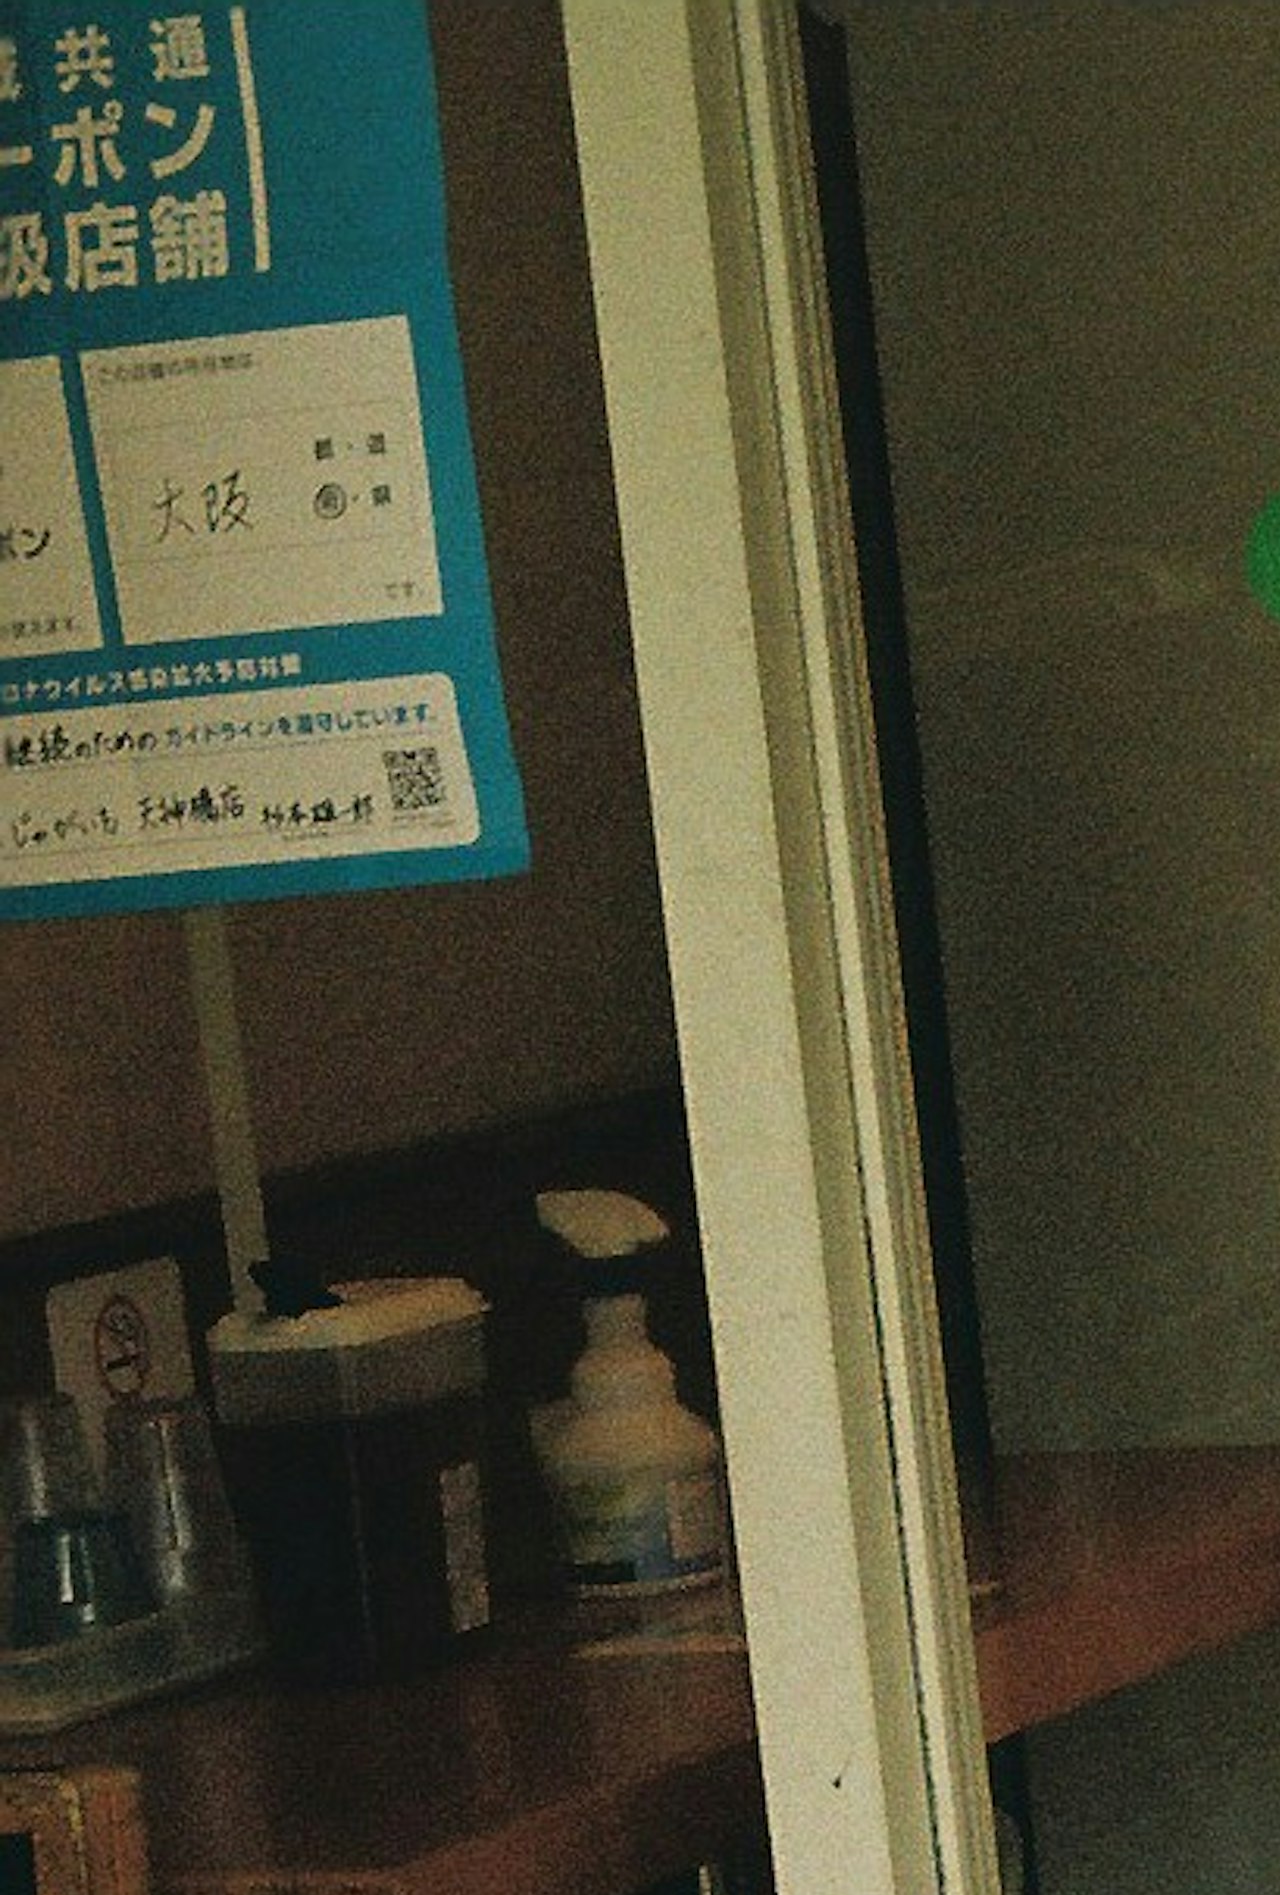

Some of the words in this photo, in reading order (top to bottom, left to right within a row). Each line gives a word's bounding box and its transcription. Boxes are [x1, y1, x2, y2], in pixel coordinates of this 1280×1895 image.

[0, 190, 229, 300] 扱店舗
[156, 470, 254, 543] 大阪
